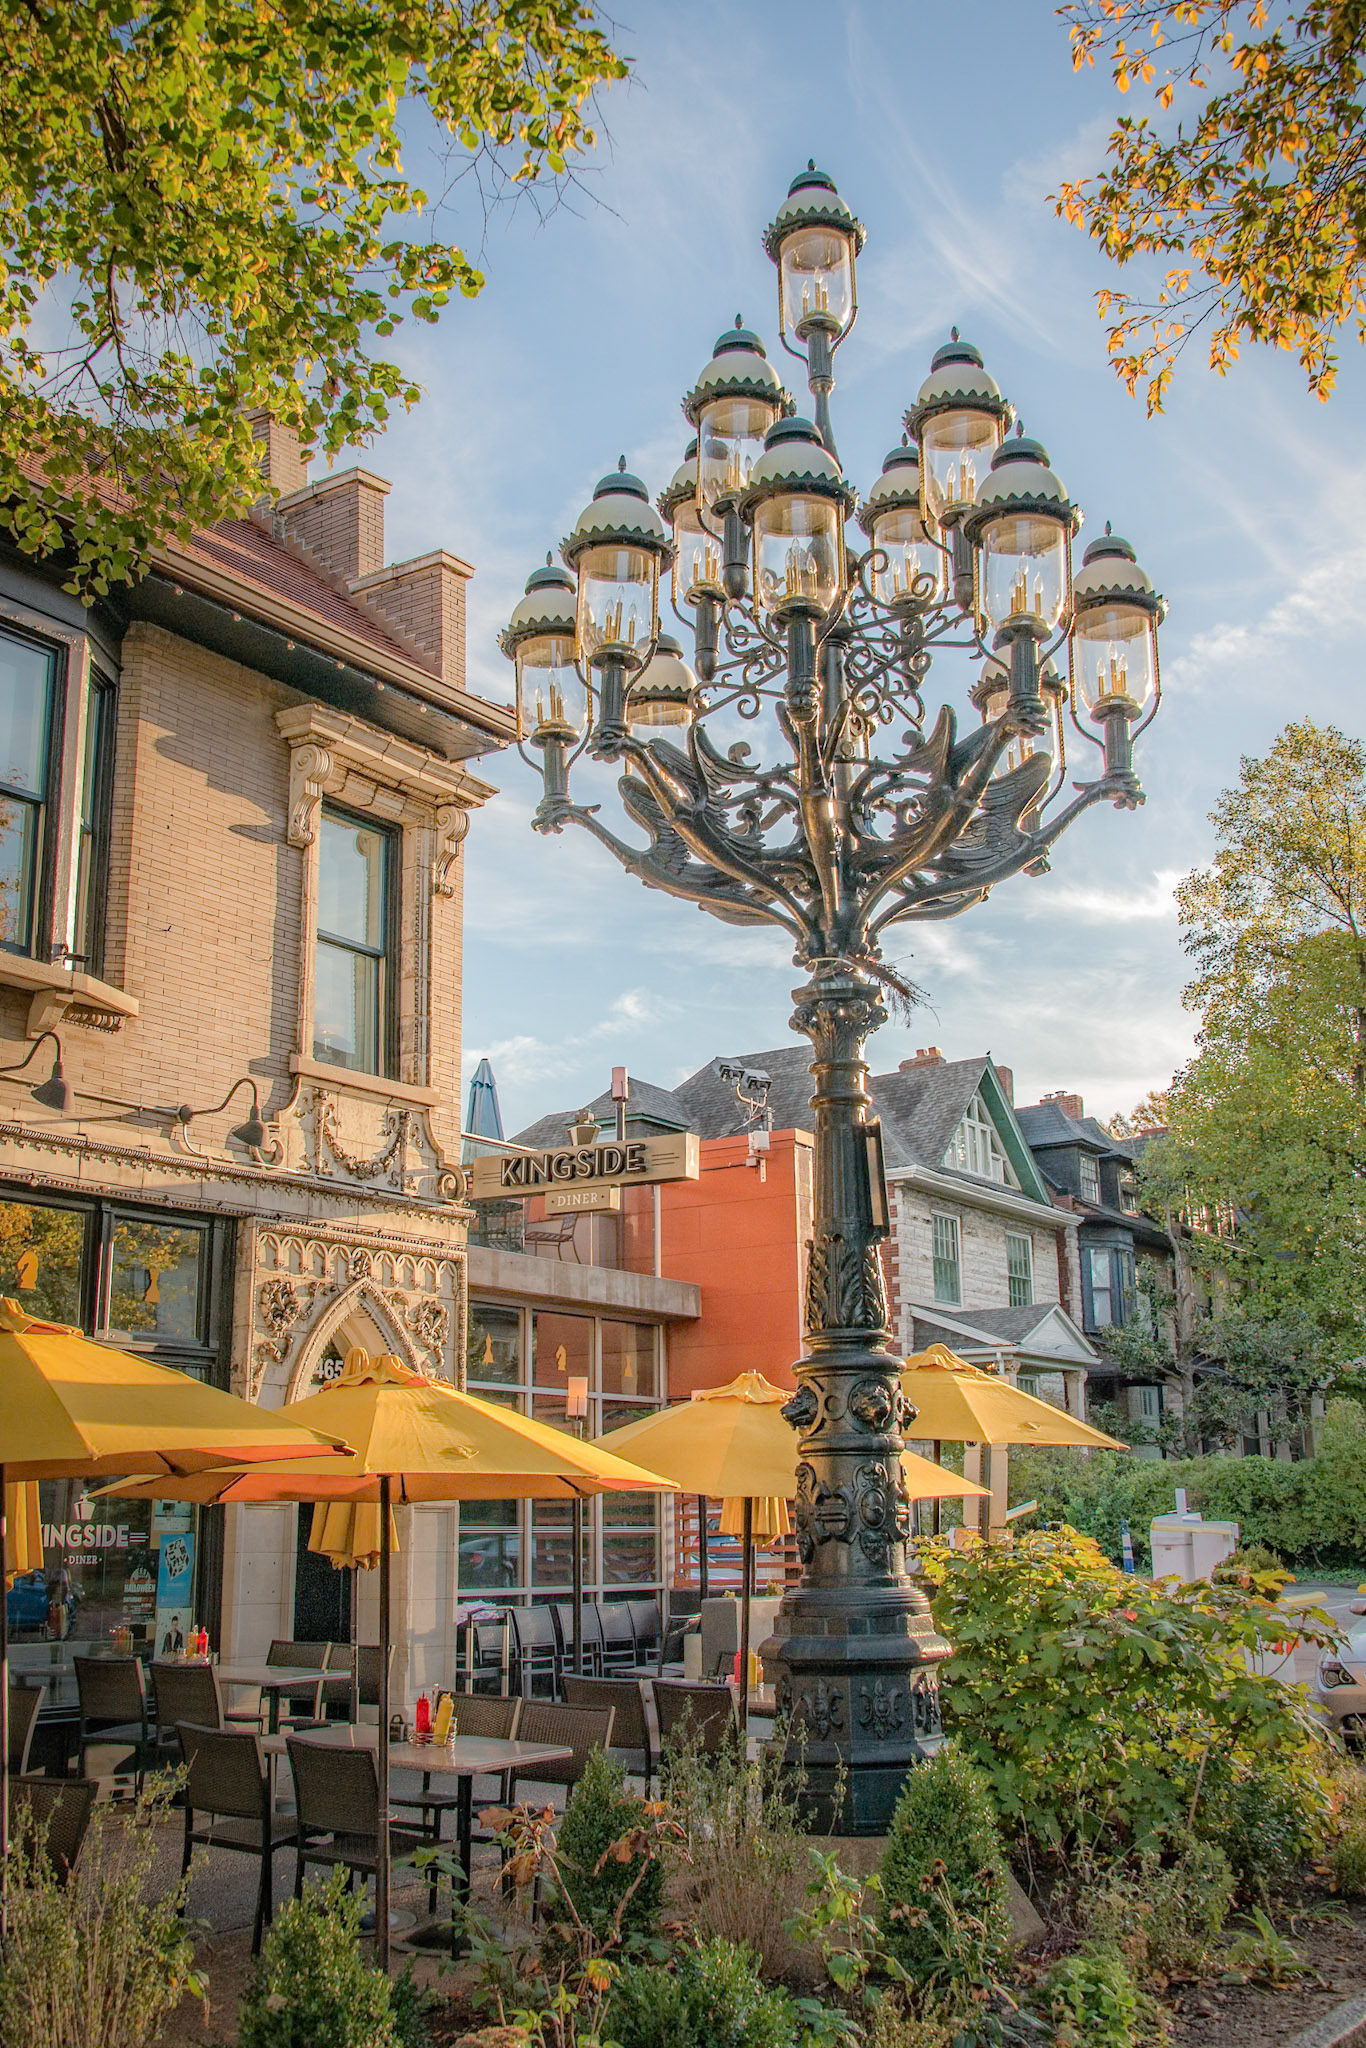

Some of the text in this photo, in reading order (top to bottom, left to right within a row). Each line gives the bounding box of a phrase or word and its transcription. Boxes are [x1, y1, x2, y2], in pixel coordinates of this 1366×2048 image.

[501, 1143, 646, 1186] KINGSIDE
[556, 1191, 598, 1207] DINER
[41, 1524, 130, 1548] INGSIDE
[68, 1555, 98, 1565] DINER
